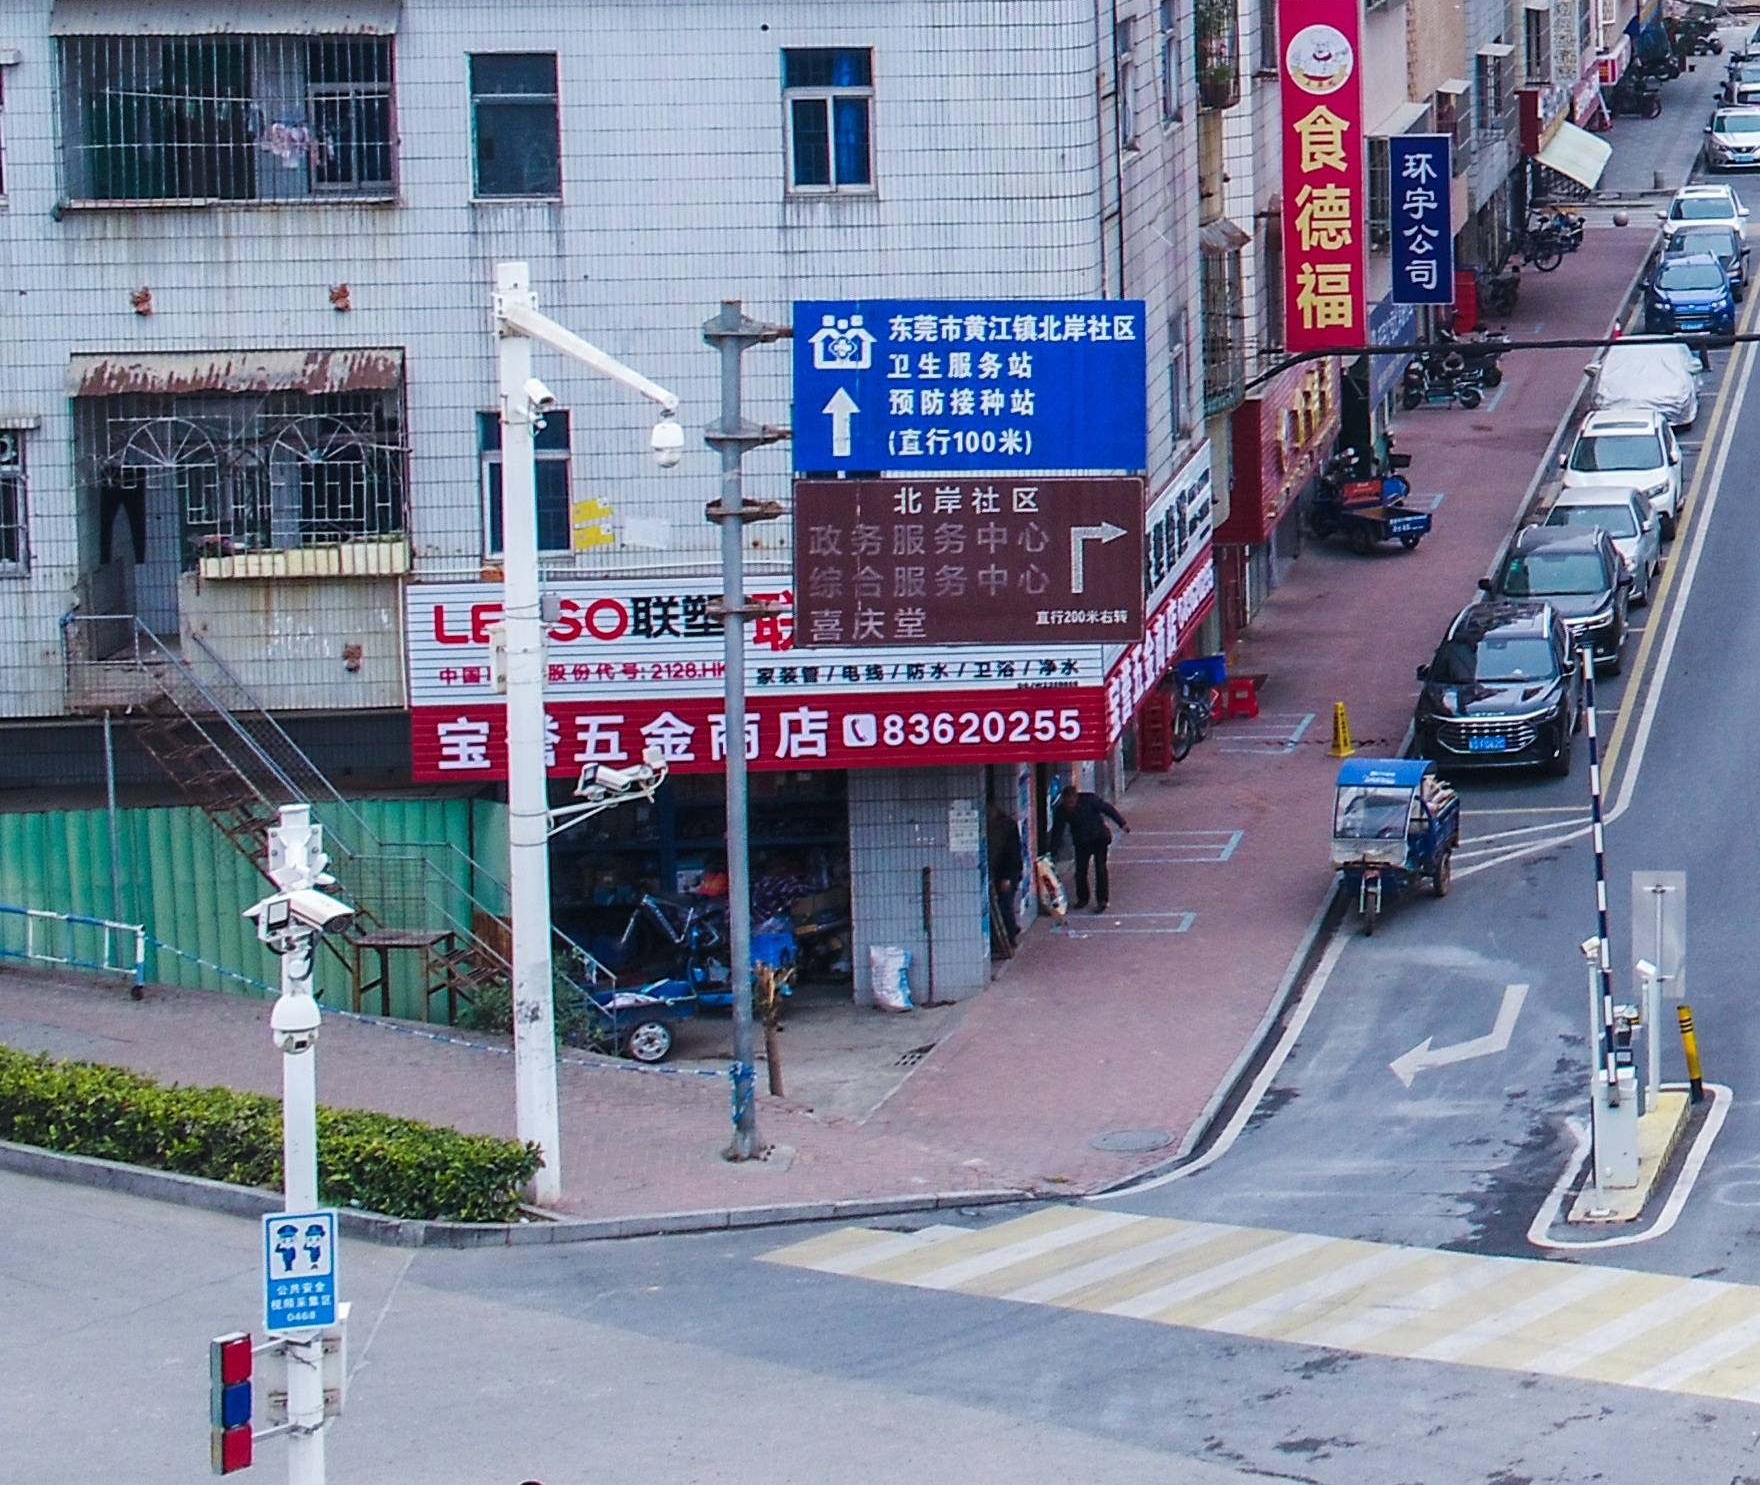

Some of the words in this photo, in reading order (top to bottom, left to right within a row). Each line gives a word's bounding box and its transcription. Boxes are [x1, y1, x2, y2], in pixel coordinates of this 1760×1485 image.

[1293, 104, 1353, 329] 食德福
[1402, 152, 1439, 291] 环宇公司
[888, 314, 1136, 342] 东莞市黄江镇北岸社区
[886, 351, 1033, 380] 卫生服务站
[888, 387, 1036, 417] 预防接种站
[887, 428, 1032, 457] (直行100米)
[893, 486, 1040, 515] 北岸社区
[808, 520, 1050, 556] 政务服务中心
[808, 563, 1051, 599] 综合服务中心
[810, 607, 927, 642] 喜庆堂
[1035, 610, 1128, 626] 直行200米右转
[882, 709, 1082, 747] 83620255
